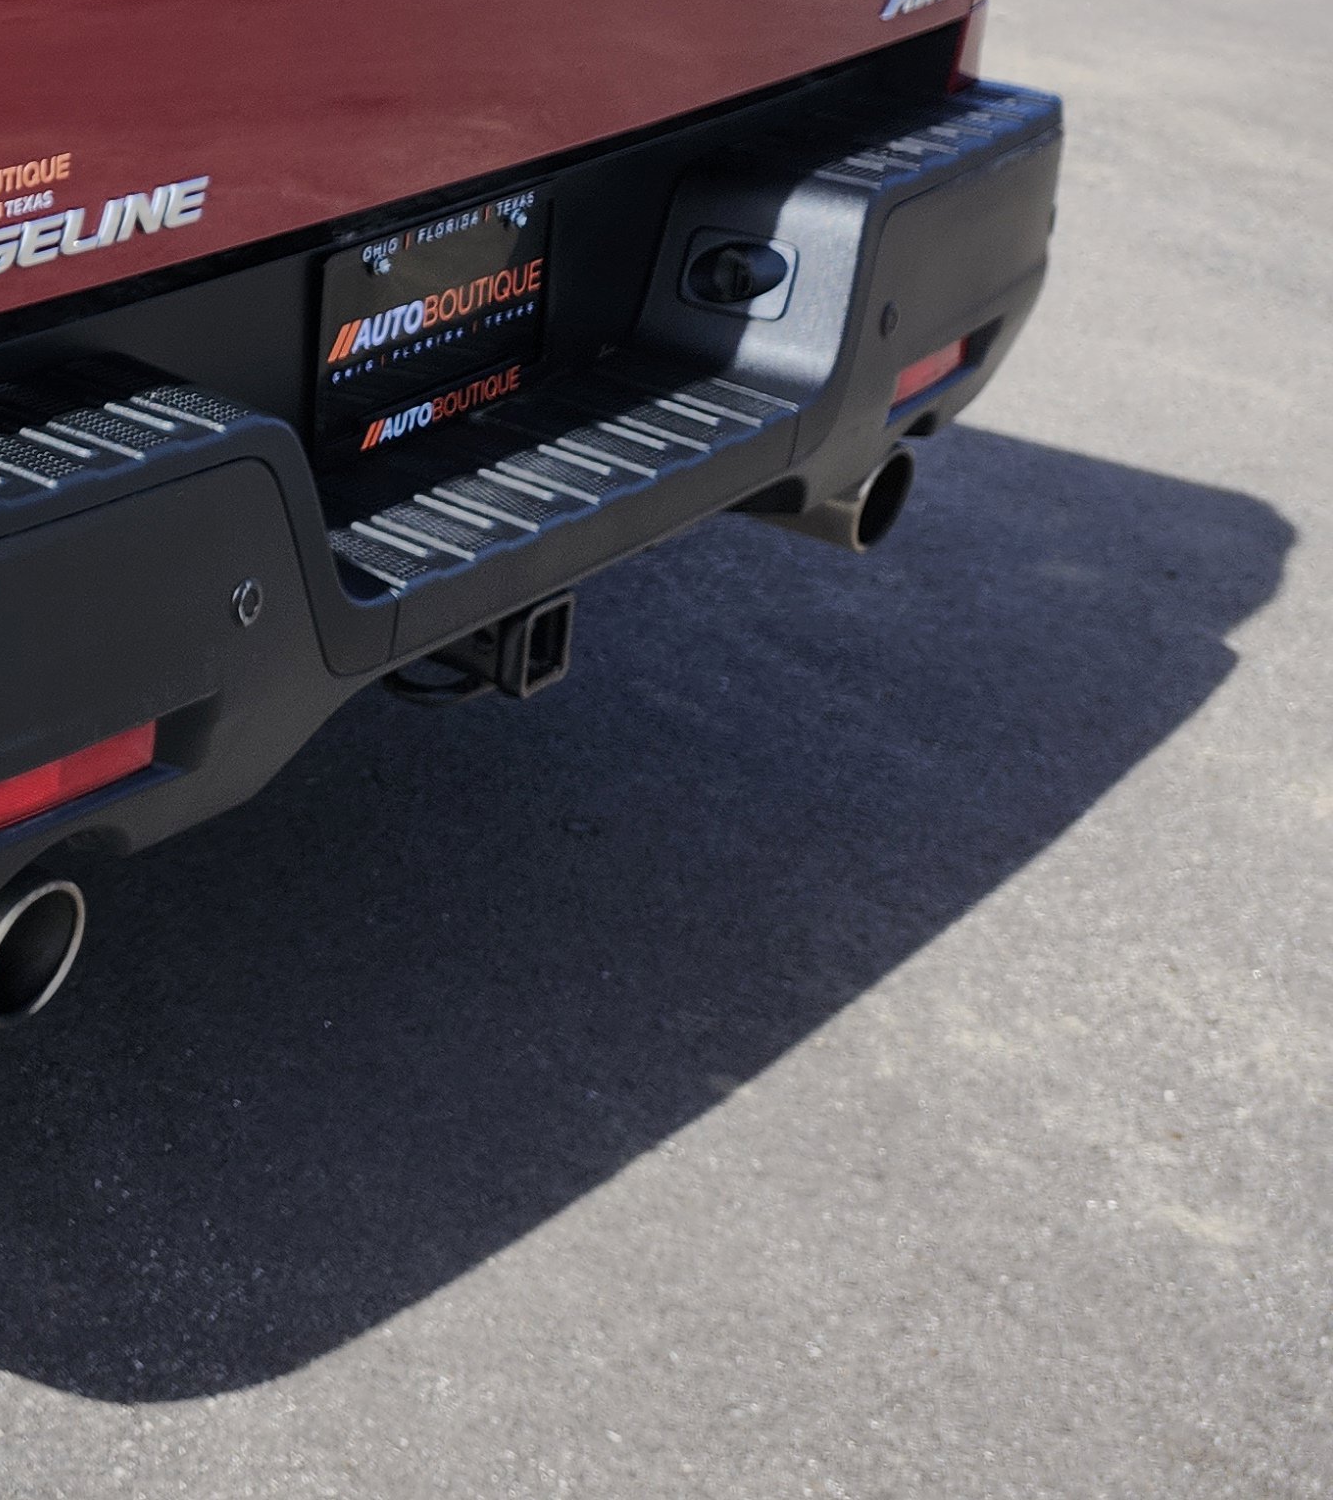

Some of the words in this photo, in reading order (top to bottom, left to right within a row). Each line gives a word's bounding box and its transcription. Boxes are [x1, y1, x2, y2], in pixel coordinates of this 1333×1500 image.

[5, 190, 54, 218] TEXAS
[351, 257, 544, 355] AUTOBOUTIQUE
[377, 364, 522, 445] AUTOBOUTIQUE
